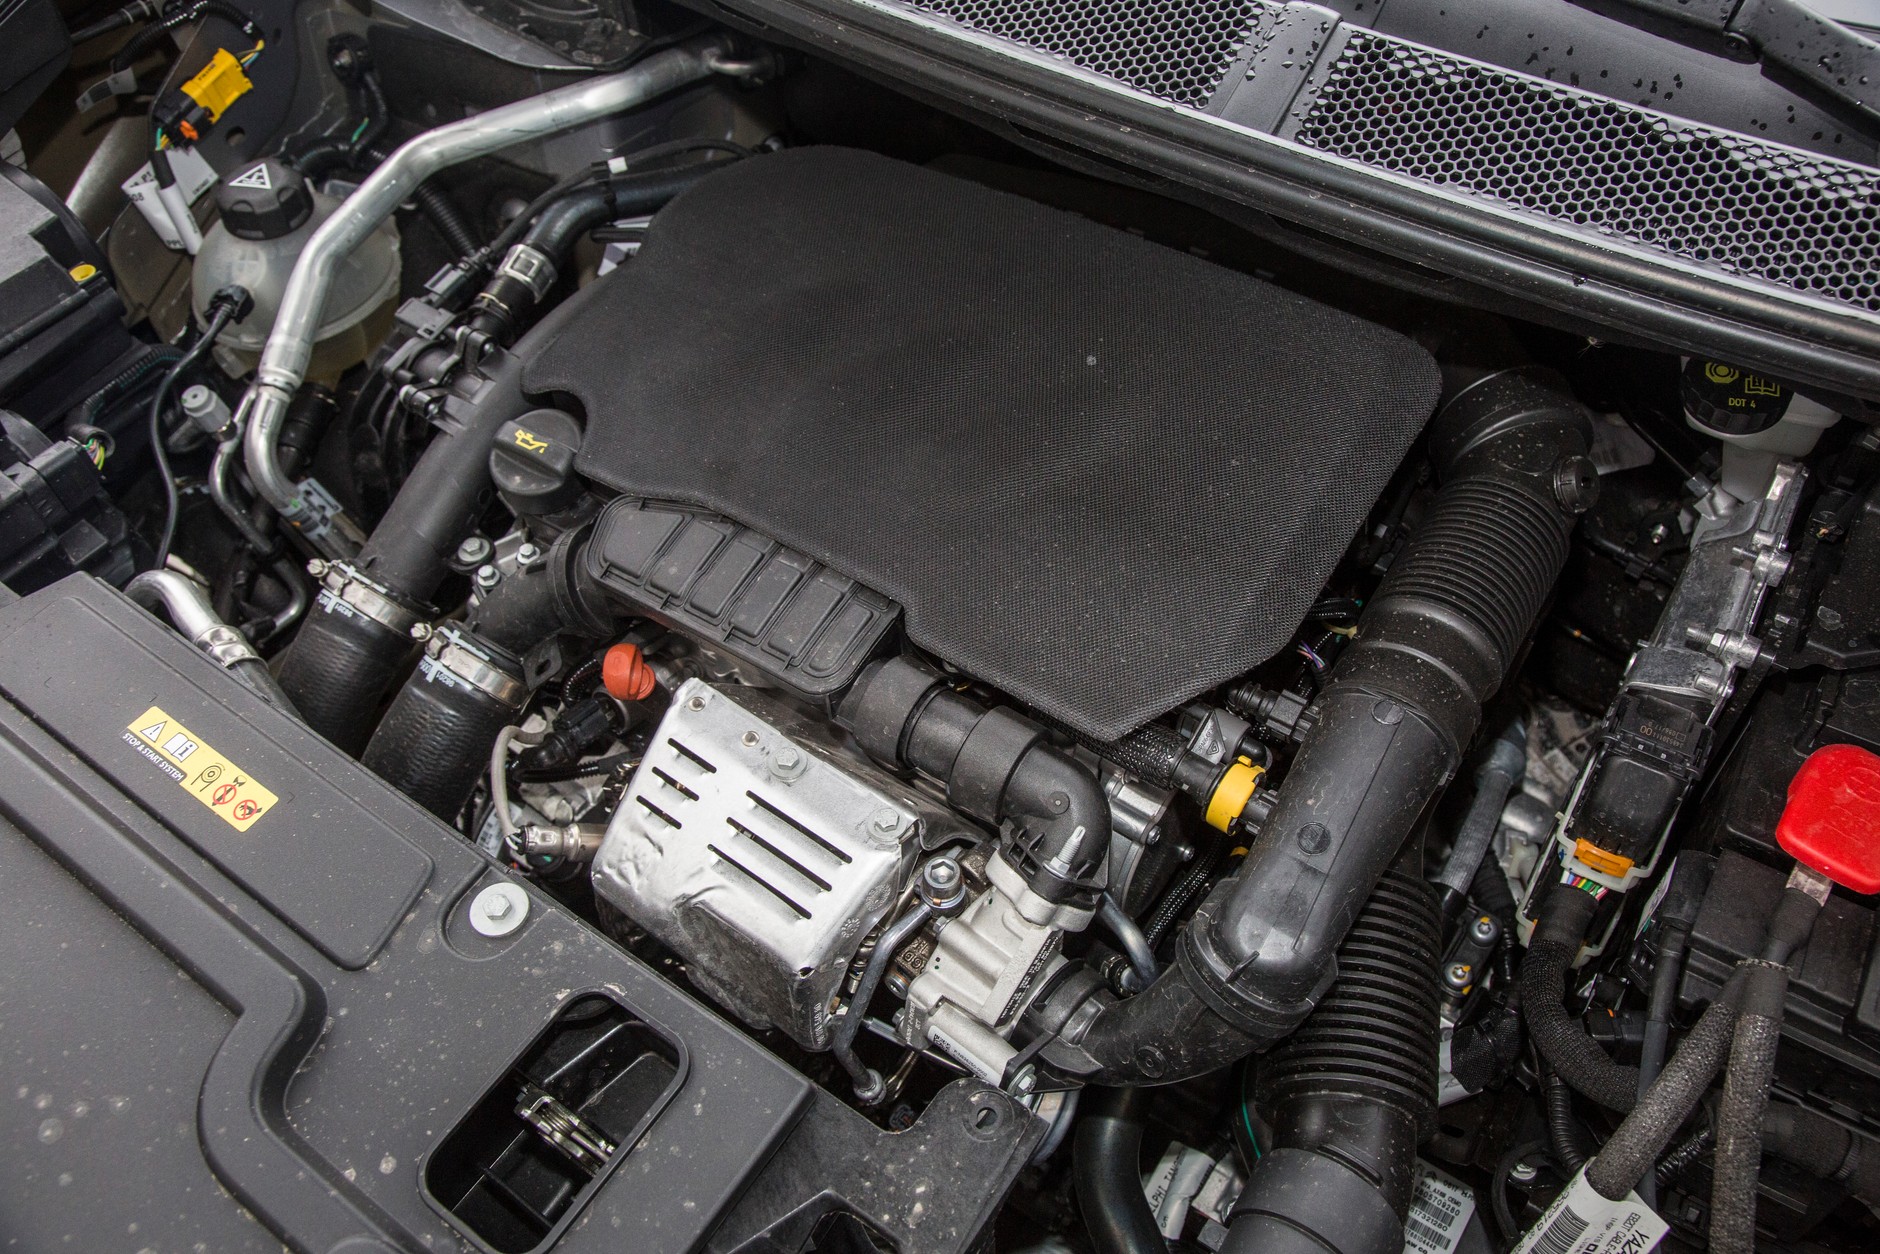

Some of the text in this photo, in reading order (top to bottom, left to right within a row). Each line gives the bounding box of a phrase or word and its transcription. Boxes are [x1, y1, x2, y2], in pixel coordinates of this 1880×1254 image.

[1728, 397, 1756, 408] DOT 4
[122, 732, 141, 747] STOP
[141, 748, 164, 764] START
[159, 761, 185, 781] SYSTEM
